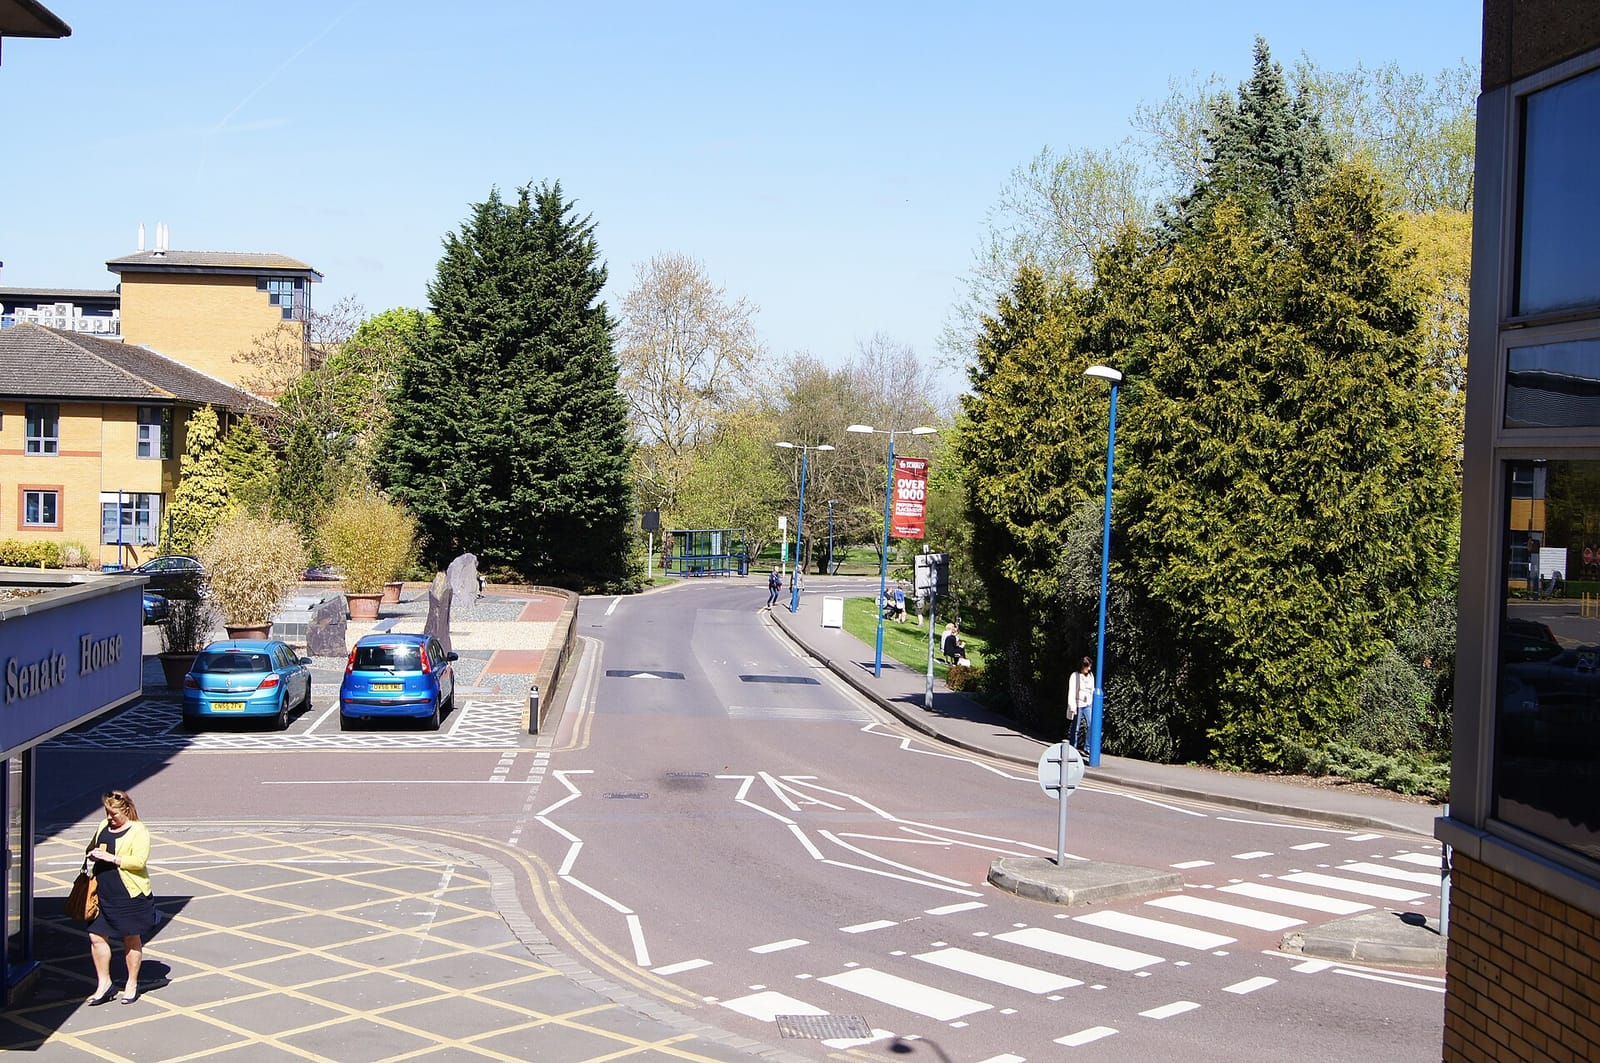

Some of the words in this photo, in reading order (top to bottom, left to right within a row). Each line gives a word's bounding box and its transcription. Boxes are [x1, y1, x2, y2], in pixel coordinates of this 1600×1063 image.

[897, 479, 925, 490] OVER
[897, 489, 924, 500] 1000
[6, 648, 67, 705] Senate
[80, 633, 122, 677] House
